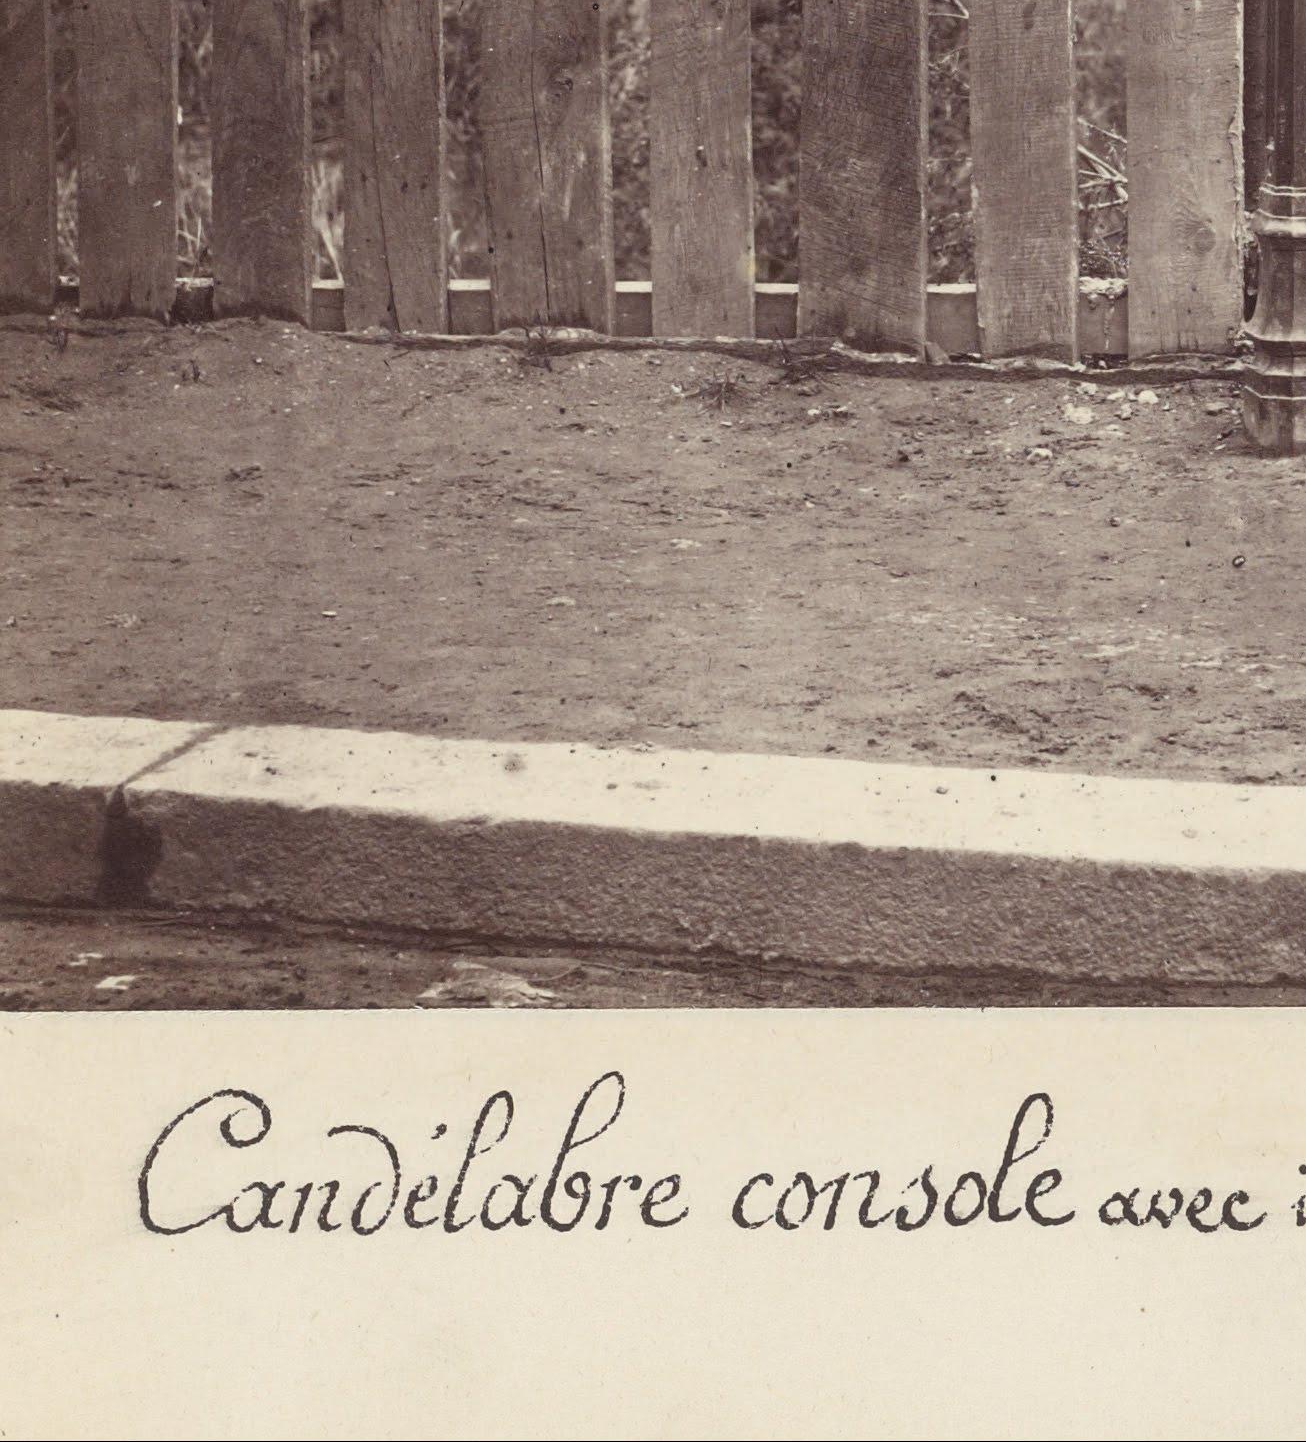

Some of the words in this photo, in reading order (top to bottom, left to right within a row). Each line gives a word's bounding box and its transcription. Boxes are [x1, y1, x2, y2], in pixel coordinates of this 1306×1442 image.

[137, 1070, 689, 1236] Candélabre
[731, 1092, 1076, 1232] console
[1098, 1187, 1268, 1234] avec
